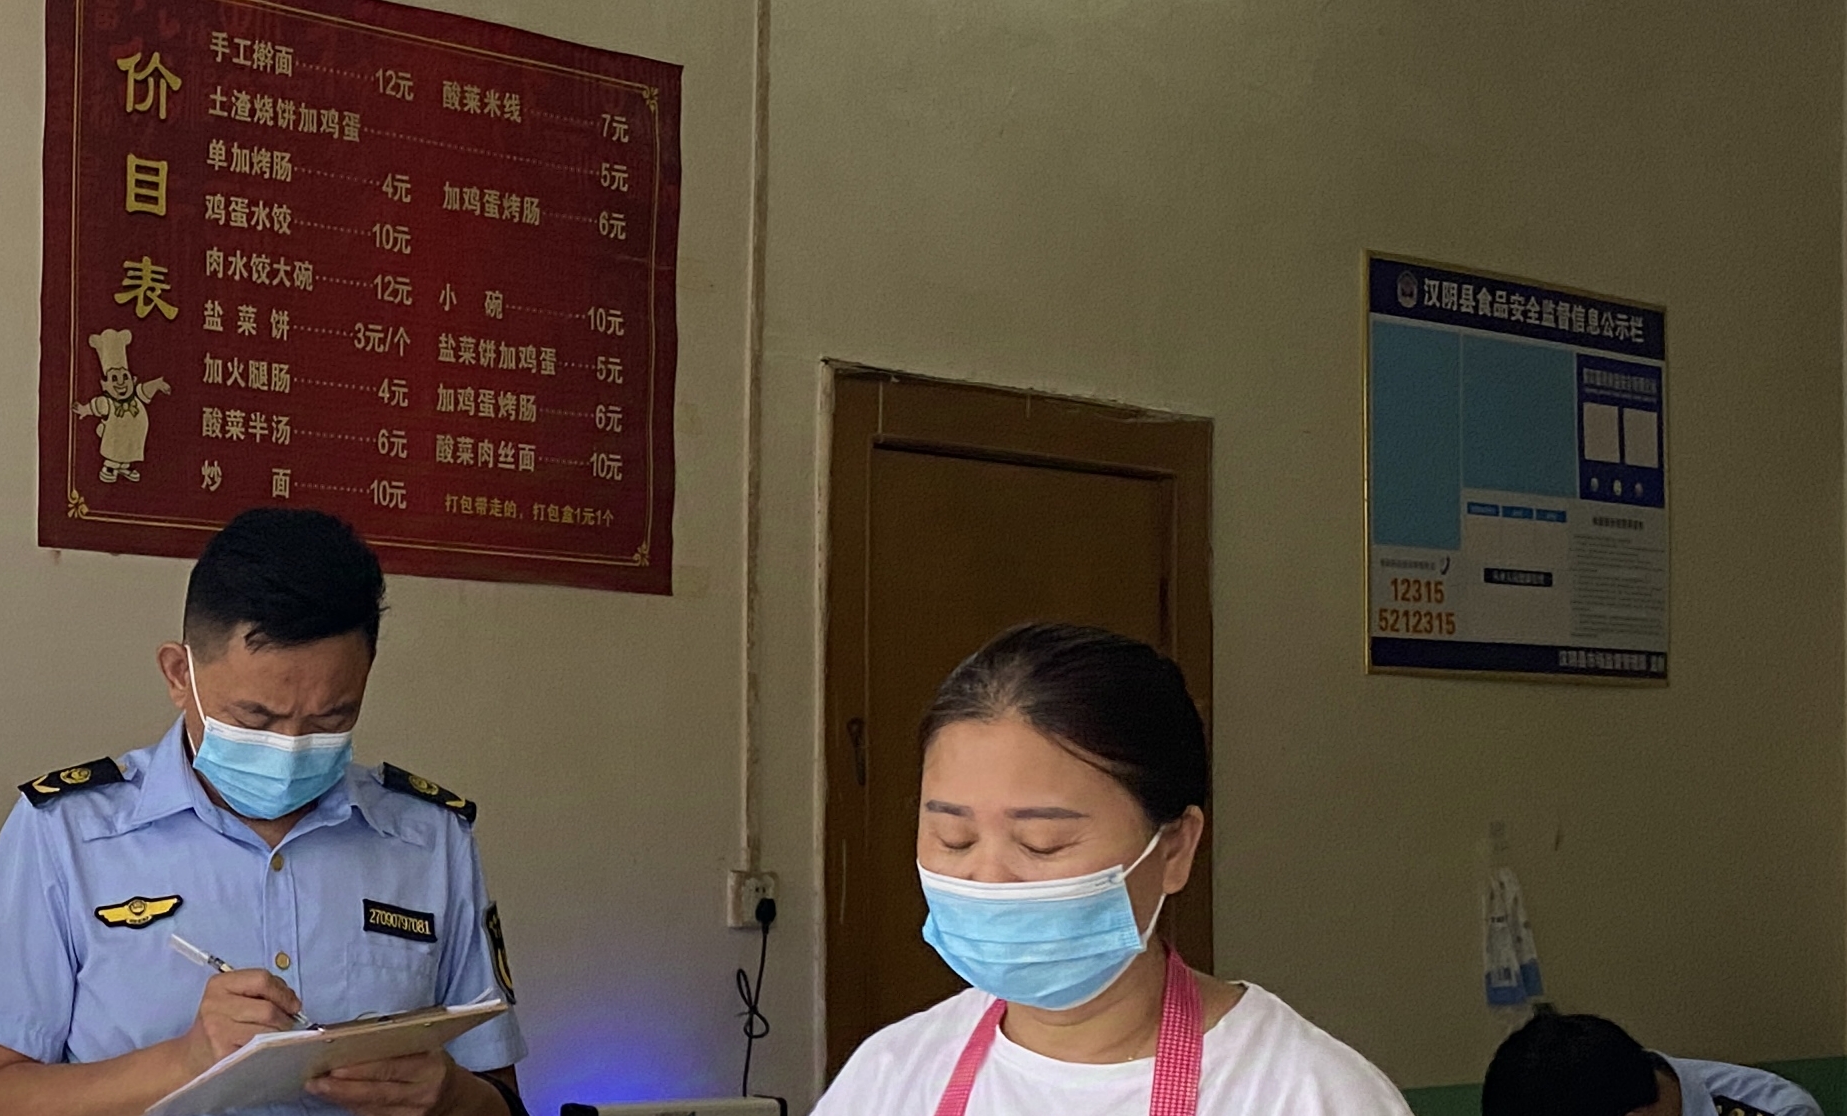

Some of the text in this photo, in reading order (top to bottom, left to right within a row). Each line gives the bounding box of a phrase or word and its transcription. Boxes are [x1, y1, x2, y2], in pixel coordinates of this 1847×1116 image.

[209, 31, 414, 101] 手工擀面 12元
[208, 85, 629, 192] 土渣烧饼加鸡蛋 5元
[601, 113, 629, 143] 7元
[114, 51, 182, 320] 价目表
[206, 138, 412, 203] 单加烤肠 4元
[205, 193, 412, 254] 鸡蛋水饺 10元
[442, 181, 627, 240] 加鸡蛋烤肠 6元
[205, 246, 413, 306] 肉水饺大碗 12元
[587, 306, 625, 336] 10元
[1423, 278, 1645, 344] 汉阴县食品安全监督信息公示栏
[353, 322, 411, 357] 3元/个
[437, 332, 624, 385] 盐菜饼加鸡蛋 5元
[202, 352, 409, 408] 加火腿肠 4元
[201, 407, 408, 459] 酸菜半汤 6元
[436, 383, 623, 433] 加鸡蛋烤肠 6元
[435, 434, 623, 481] 酸菜肉丝面 10元
[370, 479, 408, 510] 10元
[1390, 577, 1445, 604] 12315
[1378, 607, 1457, 636] 5212315
[369, 908, 432, 935] 27090797081
